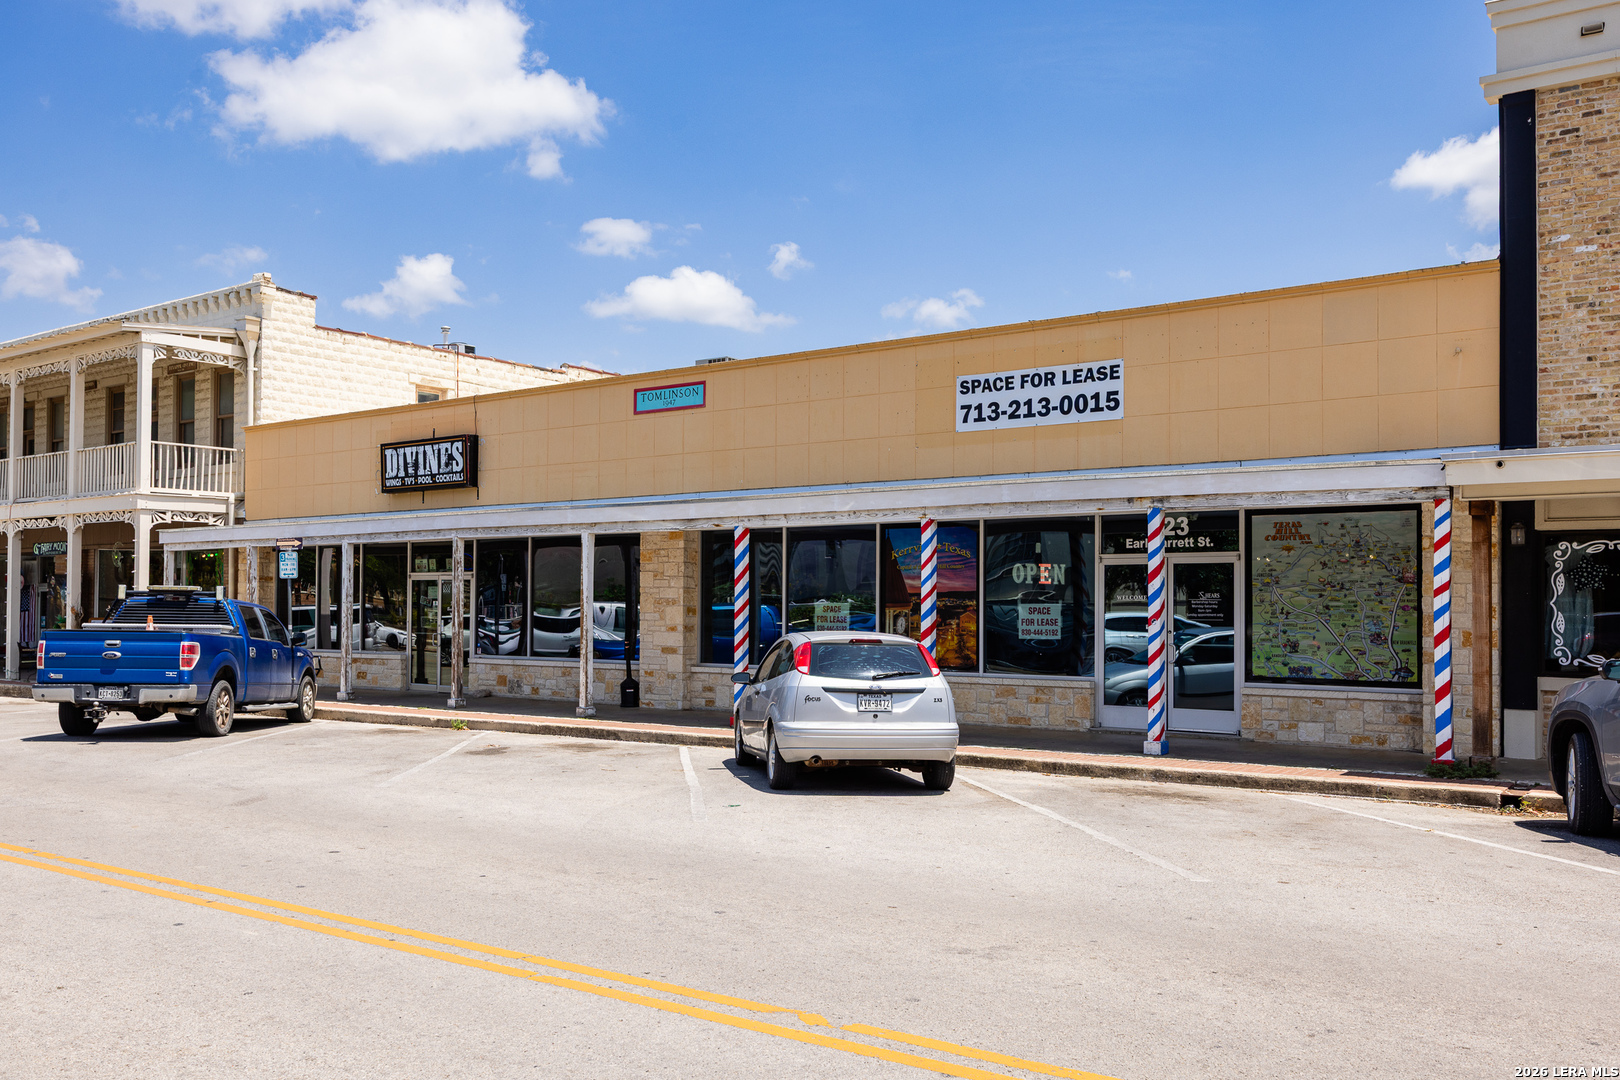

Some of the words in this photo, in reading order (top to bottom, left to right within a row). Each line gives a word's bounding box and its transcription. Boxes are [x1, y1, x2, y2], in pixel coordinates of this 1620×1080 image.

[959, 375, 1015, 395] SPACE
[1020, 371, 1056, 389] FOR
[1062, 364, 1121, 385] LEASE
[640, 386, 699, 403] TOMLINSON
[960, 390, 1120, 424] 713-213-0015
[384, 441, 464, 479] DIVINES
[385, 478, 402, 487] WINGS
[417, 475, 432, 484] POOL
[435, 472, 464, 483] COCKTAILS
[1163, 516, 1190, 536] 23
[1273, 521, 1303, 529] TEXAS
[1125, 538, 1148, 549] Earl
[1164, 537, 1194, 548] rrett
[1197, 536, 1214, 547] St.
[1264, 533, 1312, 541] COUNTRY
[891, 543, 922, 560] Kerrvi
[942, 542, 971, 559] Texas
[1012, 563, 1066, 585] OPEN
[822, 605, 842, 613] SPACE
[1028, 606, 1051, 615] SPACE
[816, 615, 828, 623] FOR
[829, 615, 848, 623] LEASE
[1021, 618, 1035, 626] FOR
[1036, 618, 1059, 626] LEASE
[1021, 628, 1059, 636] 830-444-5192
